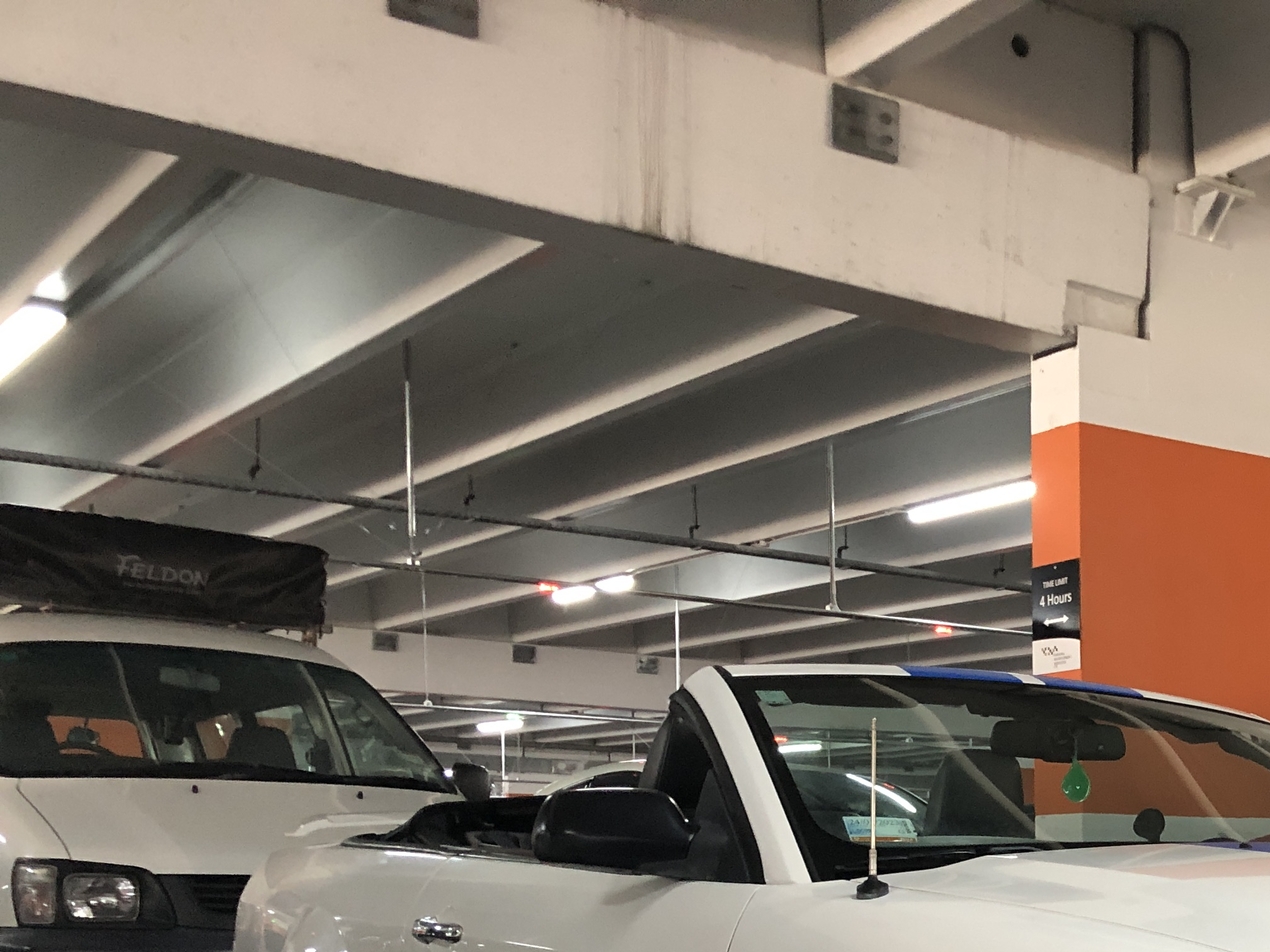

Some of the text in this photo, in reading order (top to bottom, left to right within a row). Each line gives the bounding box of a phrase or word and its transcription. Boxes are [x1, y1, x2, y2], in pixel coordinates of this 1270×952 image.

[116, 554, 210, 586] FELDON
[1042, 577, 1069, 589] TIME LIMIT
[1039, 592, 1073, 607] 4 Hours
